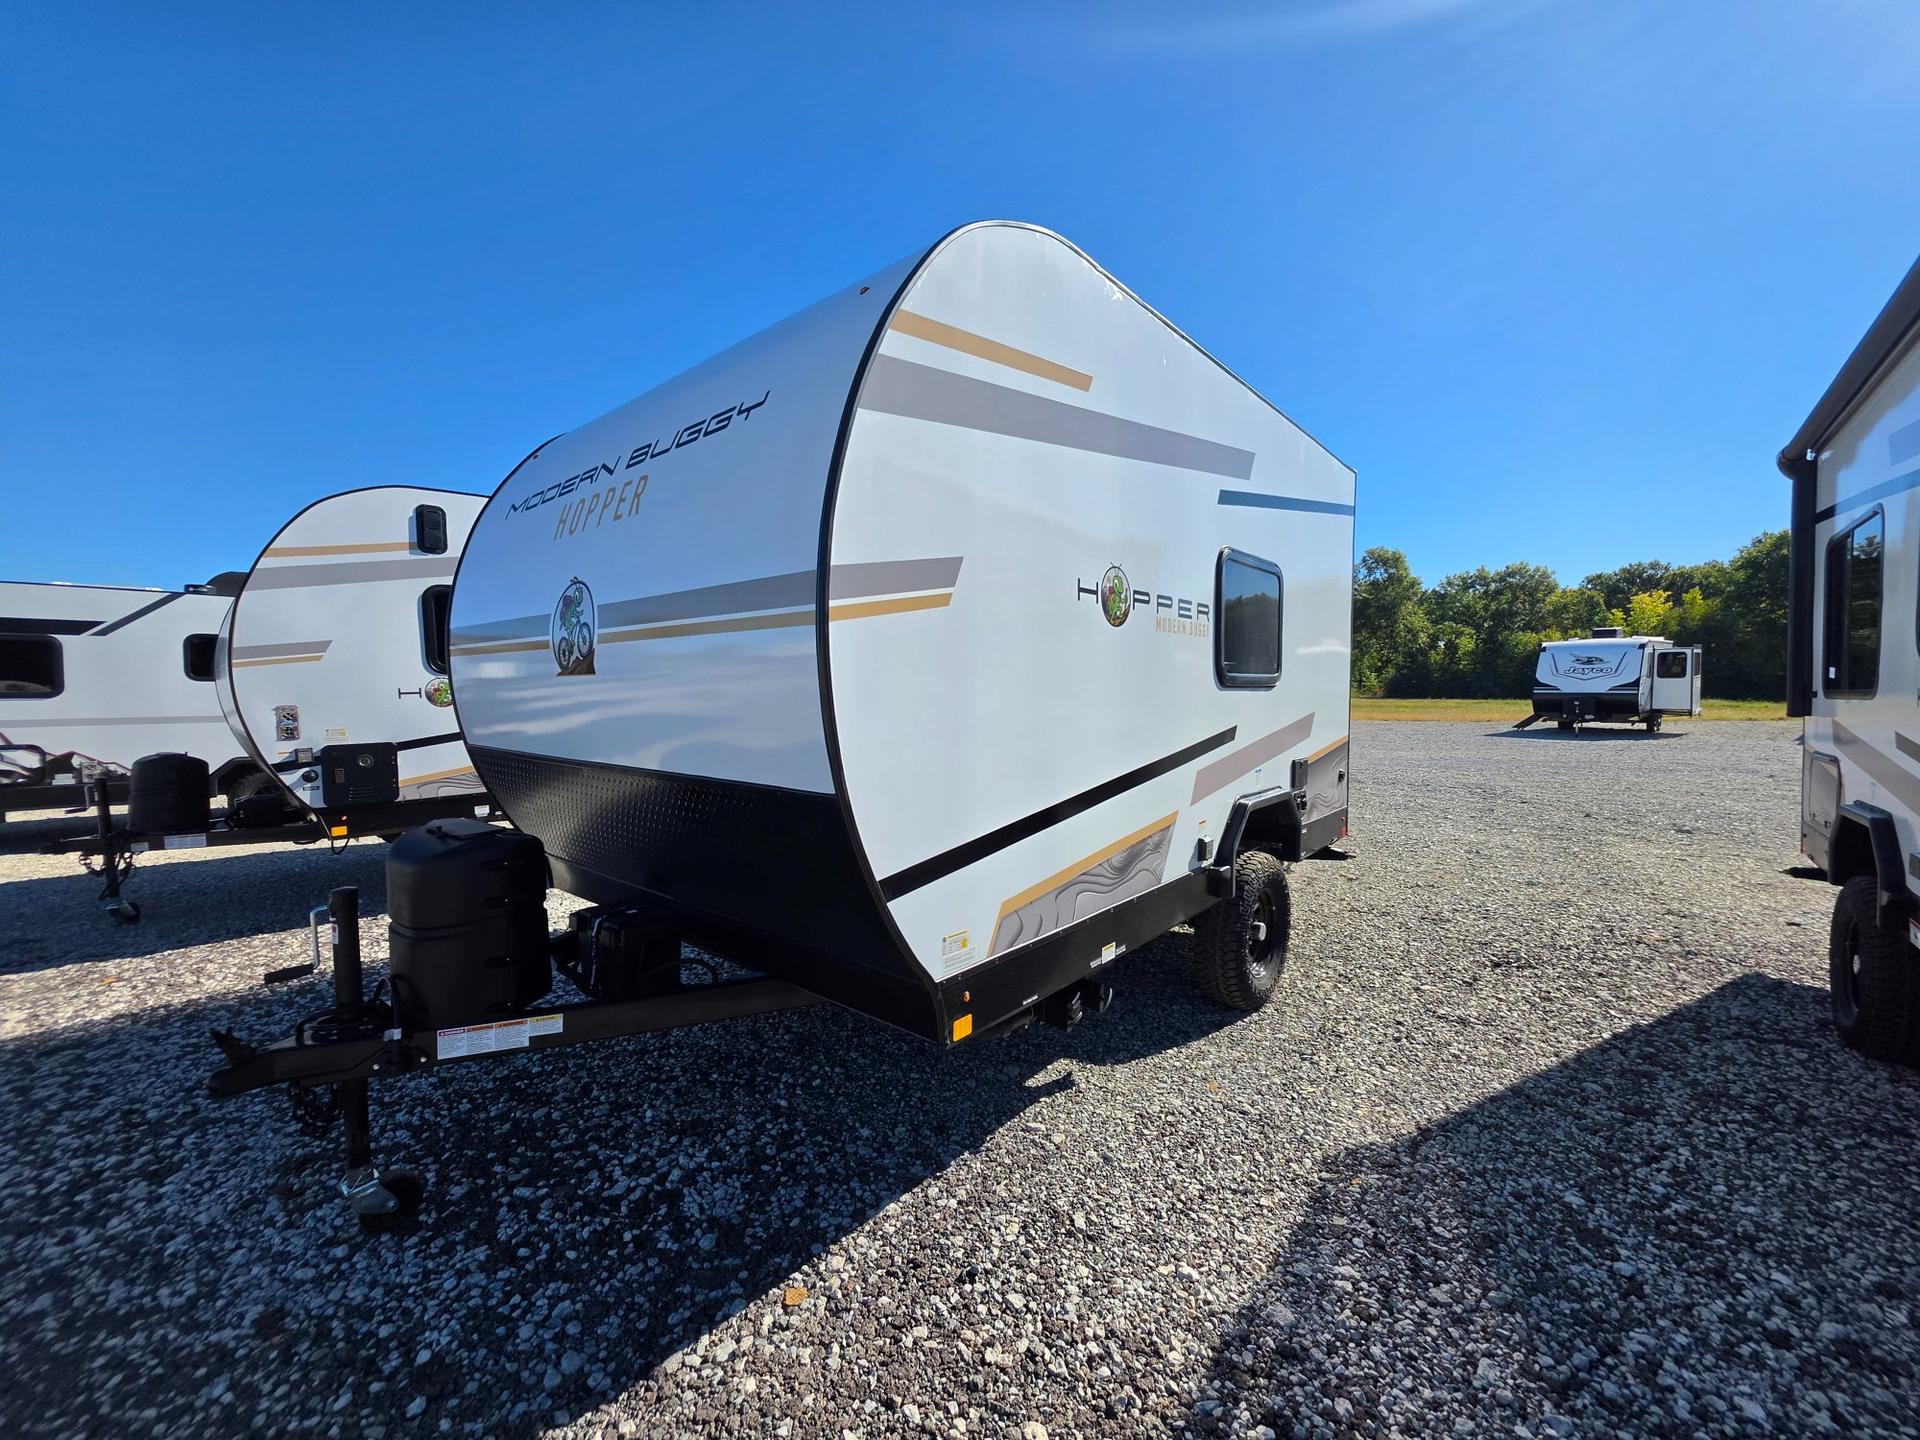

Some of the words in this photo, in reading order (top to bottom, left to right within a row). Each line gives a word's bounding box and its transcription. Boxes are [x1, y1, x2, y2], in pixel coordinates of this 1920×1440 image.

[505, 455, 621, 520] MODERN
[625, 390, 771, 470] BUGGY
[554, 474, 649, 541] HOPPER
[1077, 563, 1210, 628] HOPPER
[1155, 616, 1186, 634] MODERN
[1563, 665, 1613, 675] Jayco
